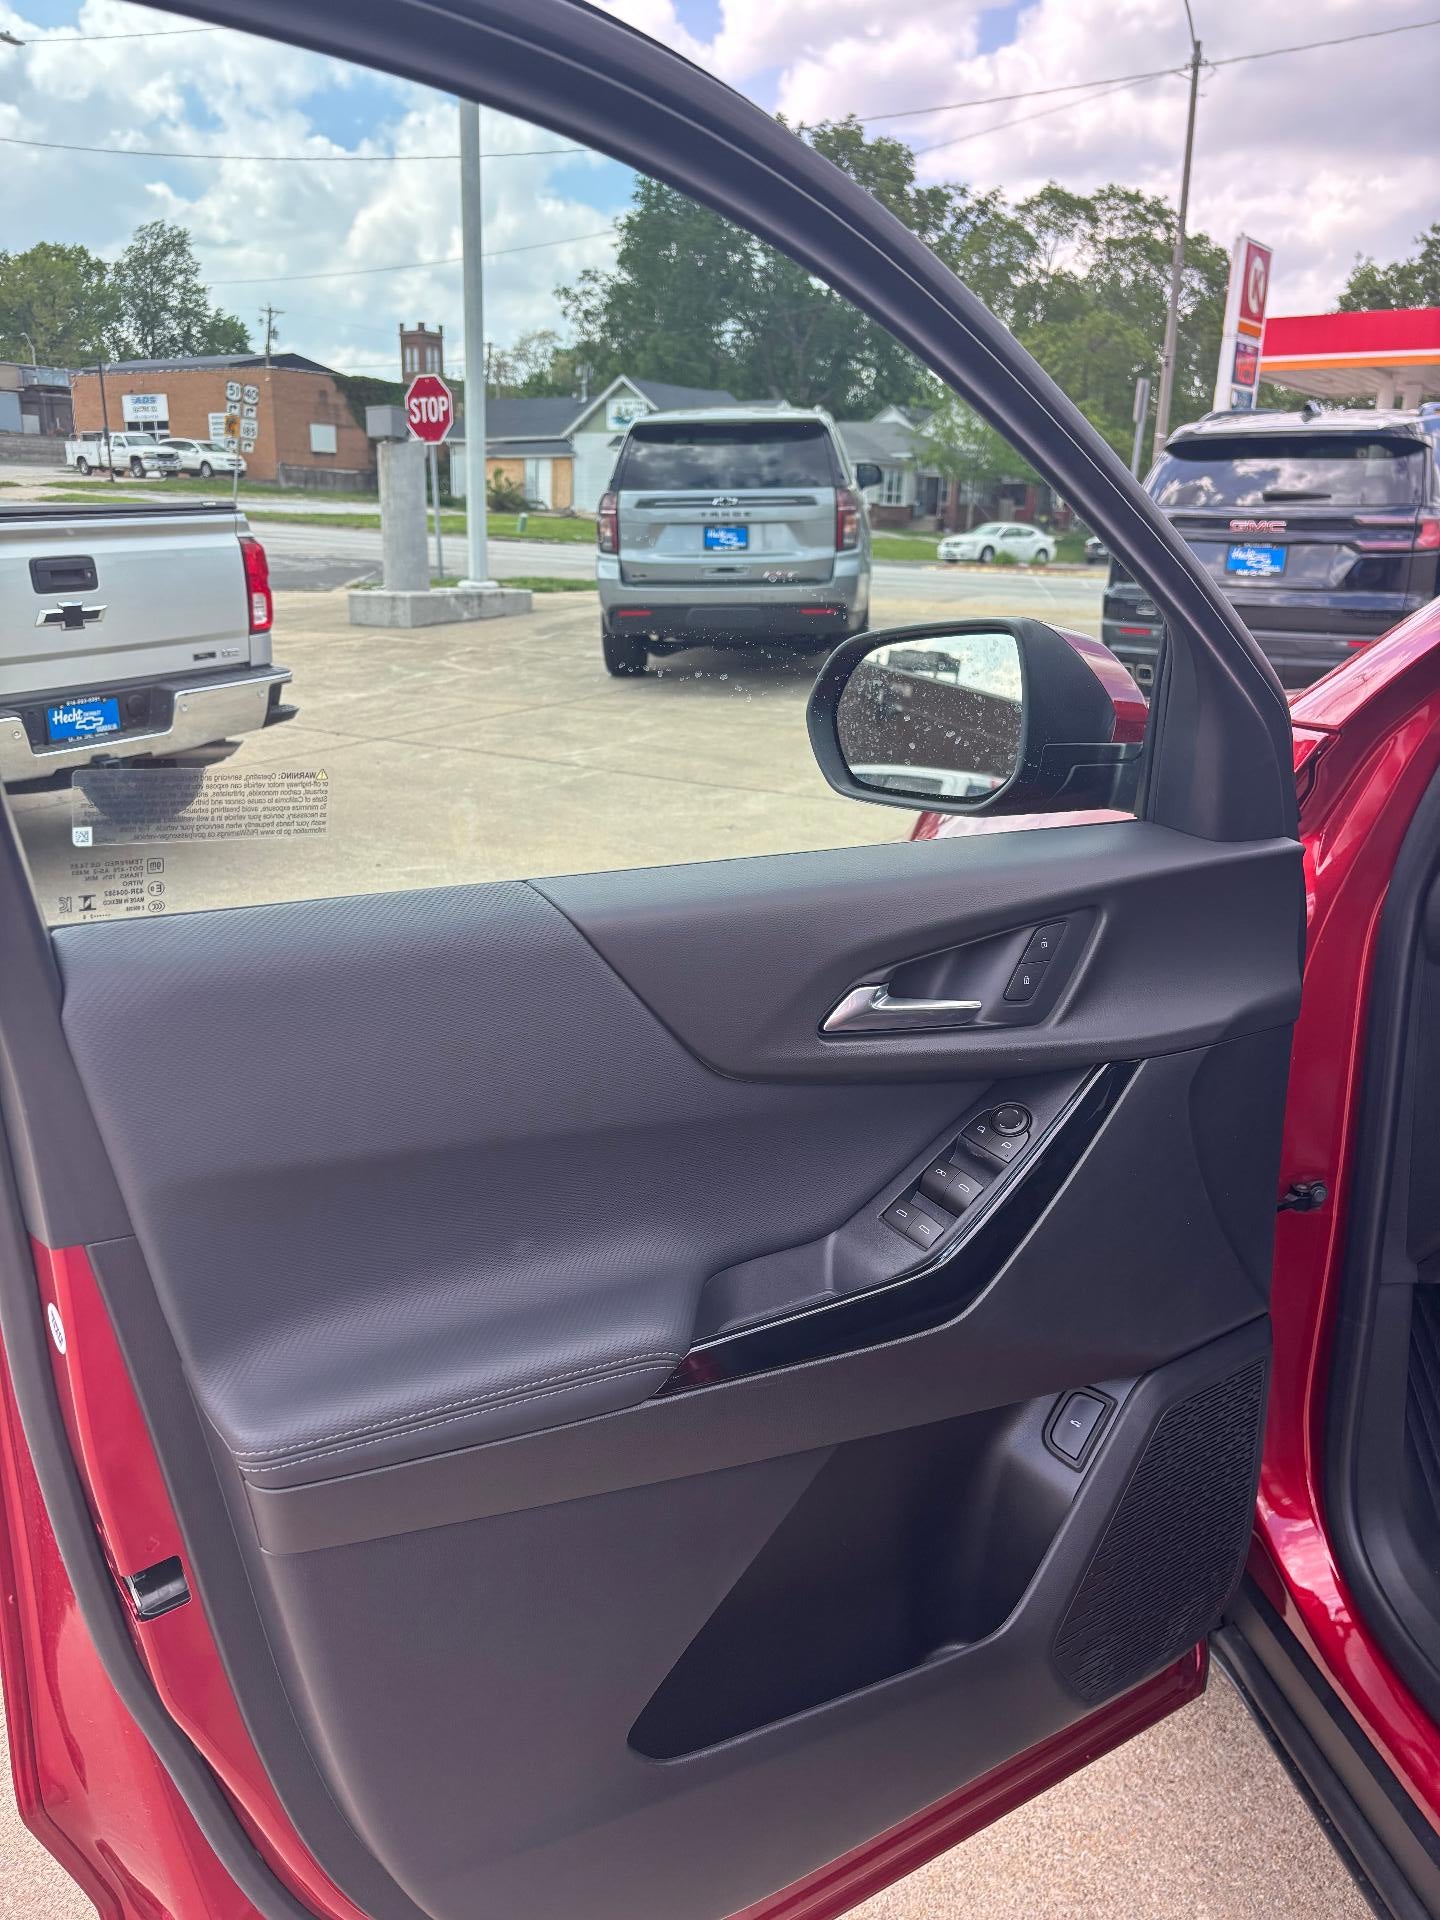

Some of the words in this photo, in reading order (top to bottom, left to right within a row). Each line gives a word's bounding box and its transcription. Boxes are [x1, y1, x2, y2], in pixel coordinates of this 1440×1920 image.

[409, 396, 449, 424] STOP
[1229, 519, 1287, 534] GMC
[52, 707, 84, 726] Hecht
